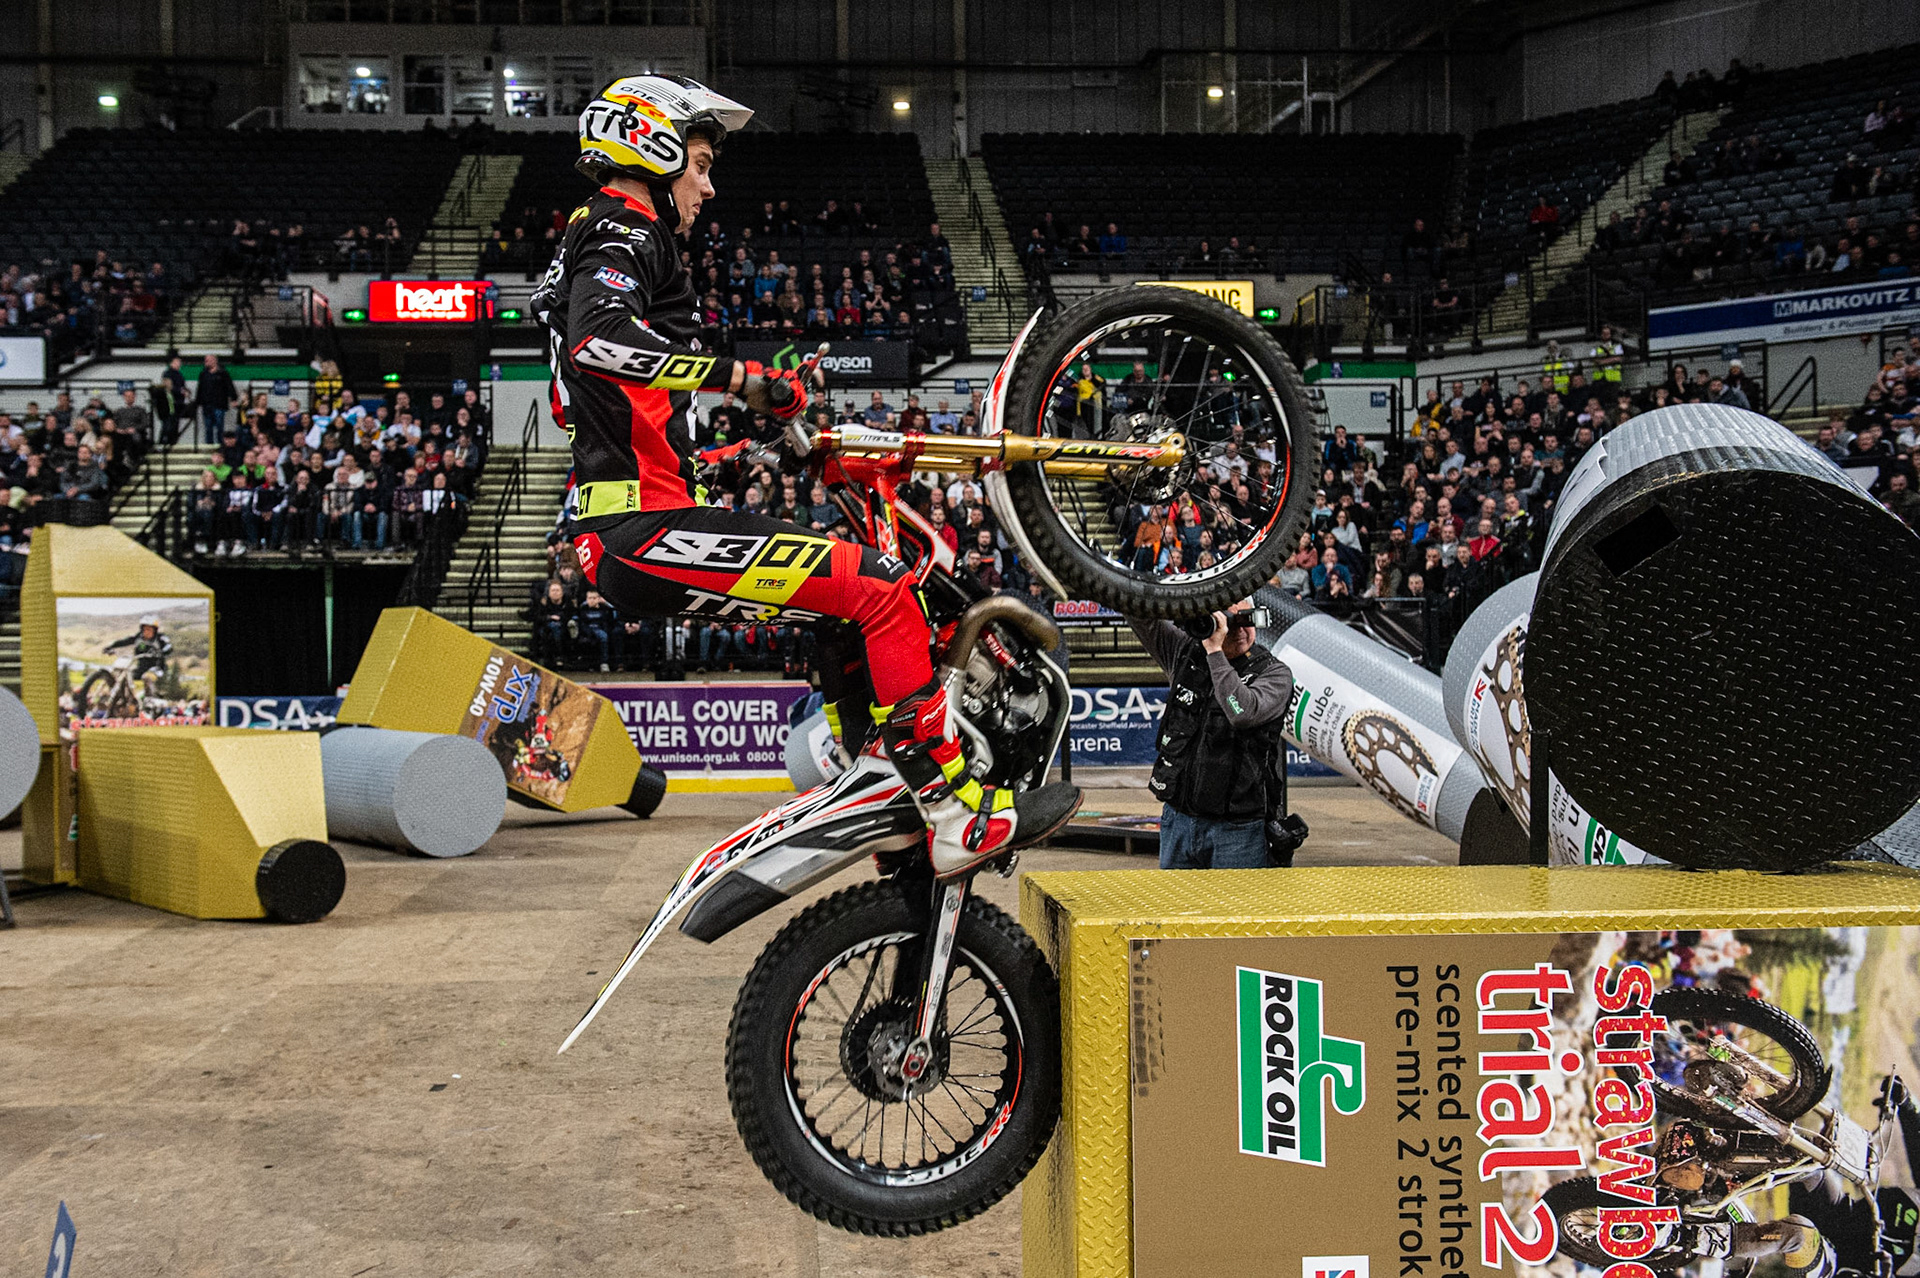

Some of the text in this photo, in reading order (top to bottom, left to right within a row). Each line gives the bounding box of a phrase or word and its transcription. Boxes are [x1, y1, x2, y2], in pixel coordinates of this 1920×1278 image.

[620, 86, 661, 104] ONE
[595, 267, 638, 288] NILS
[395, 282, 475, 311] heart
[1792, 289, 1909, 313] MARKOVITZ
[1055, 600, 1098, 615] ROAD
[469, 656, 504, 717] 10W-40
[492, 664, 534, 723] xrp
[219, 698, 311, 731] DSA
[613, 700, 778, 722] NTIAL COVER
[1070, 688, 1152, 721] DSA
[1309, 686, 1335, 722] lube
[1331, 704, 1346, 730] chains
[693, 725, 747, 747] YOU
[1099, 722, 1128, 730] Sheffield
[1129, 721, 1152, 731] Airport
[746, 751, 774, 763] 0800
[1070, 737, 1122, 752] arena
[1436, 964, 1470, 1120] scented
[1264, 975, 1296, 1155] ROCK OIL
[1387, 965, 1432, 1276] pre-mix 2 strok
[1476, 962, 1587, 1270] trial 2
